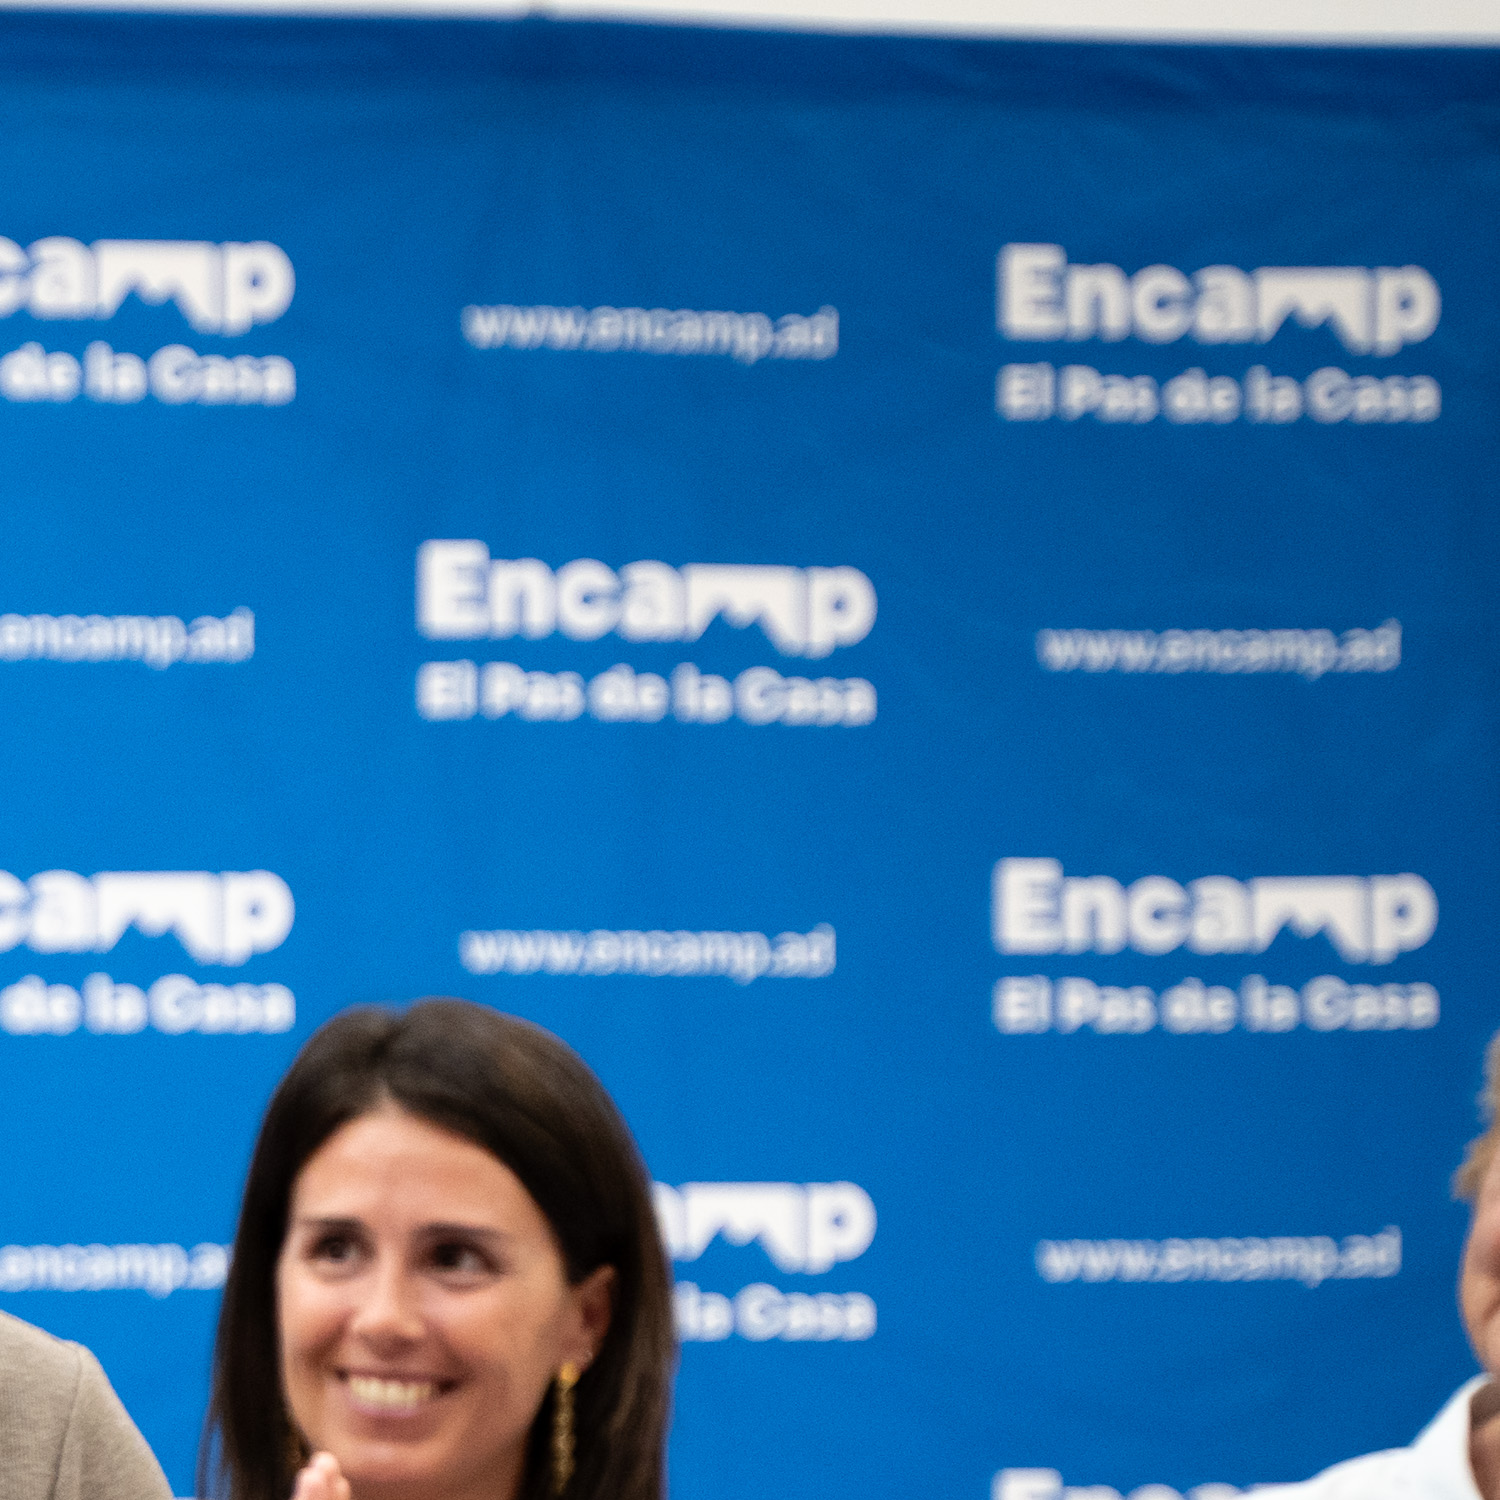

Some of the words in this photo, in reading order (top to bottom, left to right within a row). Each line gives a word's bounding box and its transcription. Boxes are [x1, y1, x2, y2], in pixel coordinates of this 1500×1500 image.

[998, 244, 1440, 355] Encamp
[465, 306, 838, 361] www.encamp.ad
[83, 342, 147, 402] la
[150, 344, 295, 404] Casa
[998, 364, 1056, 419] El
[1059, 366, 1160, 421] Pas
[1162, 369, 1241, 422] de
[1246, 367, 1302, 421] la
[1305, 368, 1440, 421] Casa
[417, 539, 877, 658] Encamp
[1042, 624, 1400, 674] www.encamp.ad
[417, 660, 478, 719] El
[481, 662, 585, 720] Pas
[588, 664, 668, 721] de
[671, 663, 732, 722] la
[735, 667, 876, 725] Casa
[993, 857, 1437, 963] Encamp
[461, 925, 836, 981] www.encamp.ad
[83, 973, 147, 1034] la
[150, 974, 295, 1034] Casa
[994, 976, 1053, 1033] El
[1056, 978, 1157, 1033] Pas
[1160, 978, 1237, 1032] de
[1240, 976, 1299, 1031] la
[1302, 976, 1439, 1030] Casa
[734, 1282, 877, 1342] Casa
